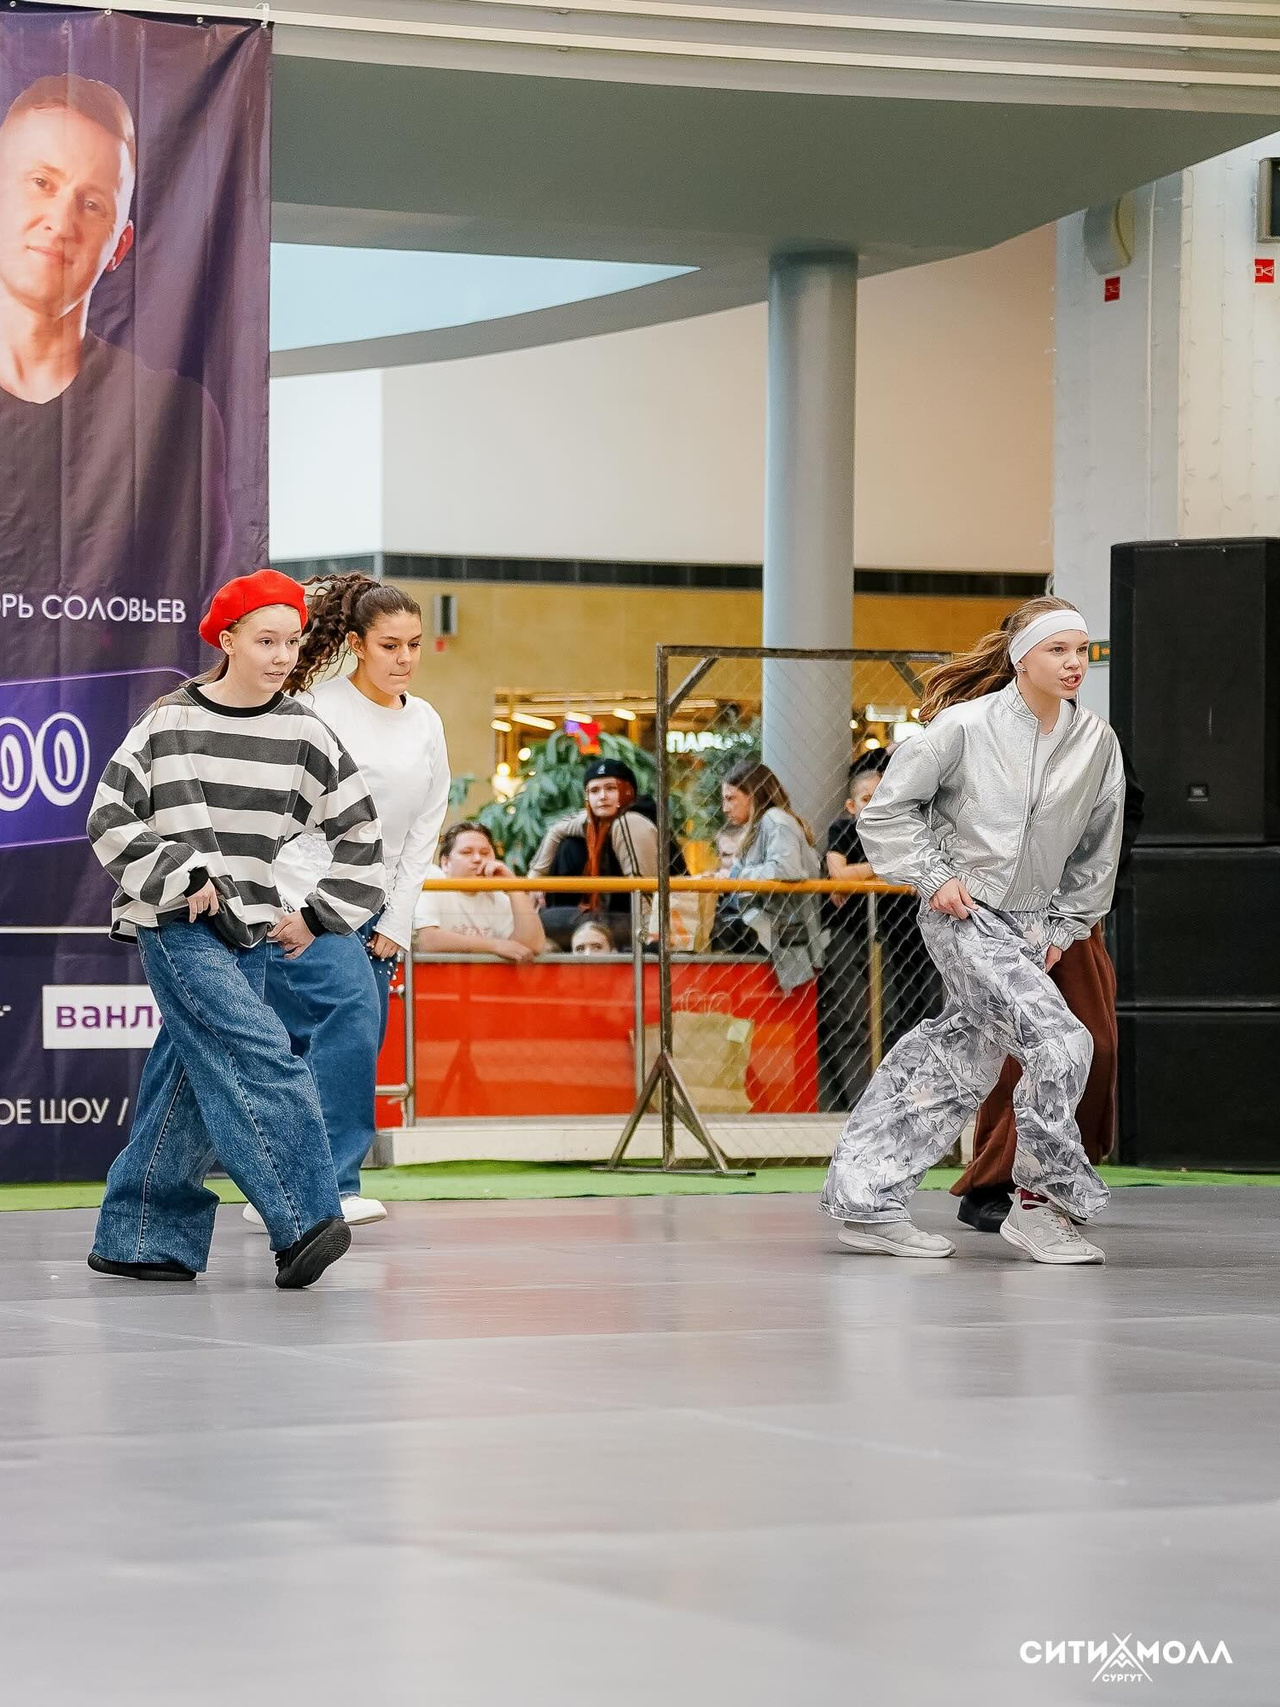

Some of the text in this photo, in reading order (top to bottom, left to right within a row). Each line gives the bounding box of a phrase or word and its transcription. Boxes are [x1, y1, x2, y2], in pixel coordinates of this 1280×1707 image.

[41, 594, 188, 624] СОЛОВЬЕВ
[56, 1005, 164, 1029] ванл
[39, 1097, 110, 1125] ШОУ
